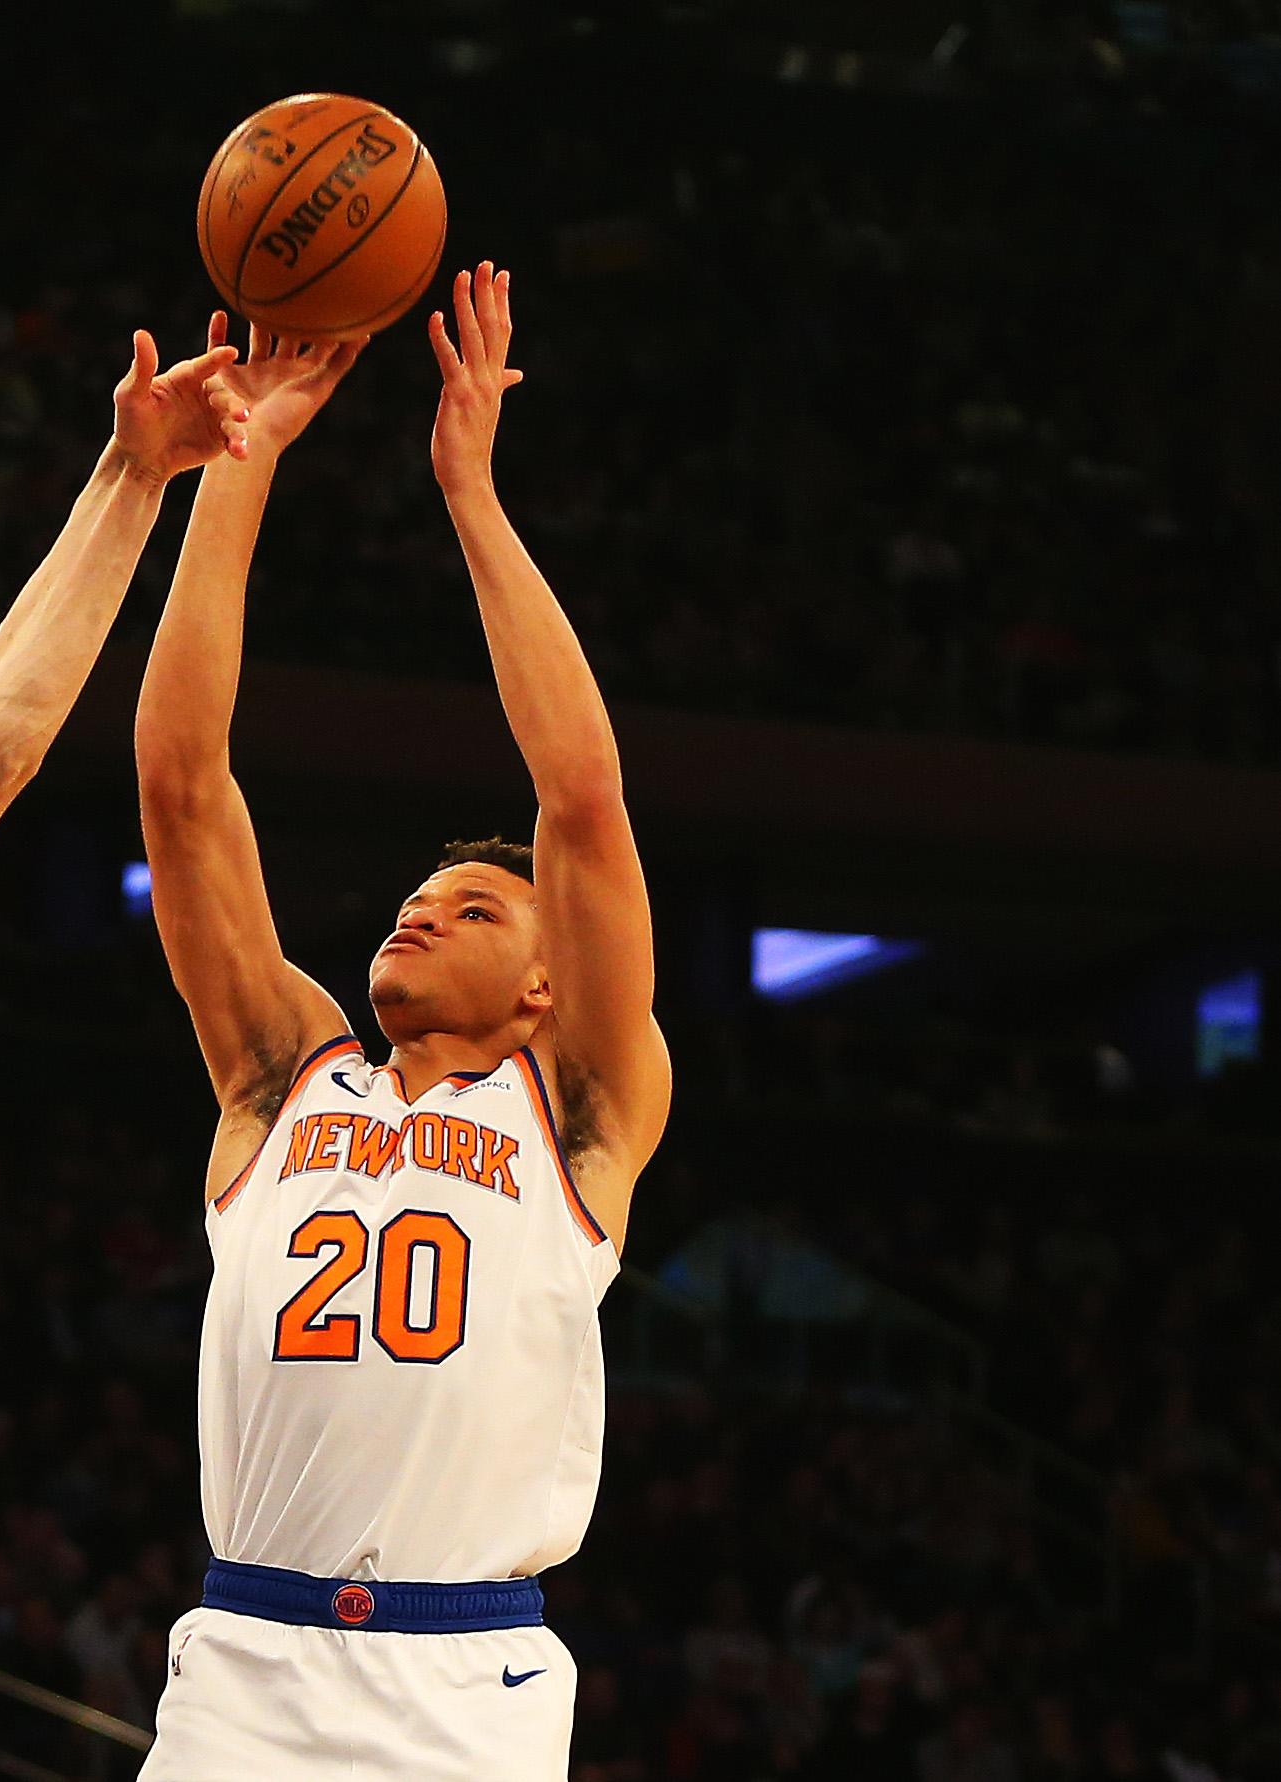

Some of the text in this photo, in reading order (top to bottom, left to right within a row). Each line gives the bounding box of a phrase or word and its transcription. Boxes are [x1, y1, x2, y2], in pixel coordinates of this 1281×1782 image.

[258, 124, 396, 268] SPALDING
[278, 1113, 400, 1184] NEW
[272, 1209, 471, 1364] 20
